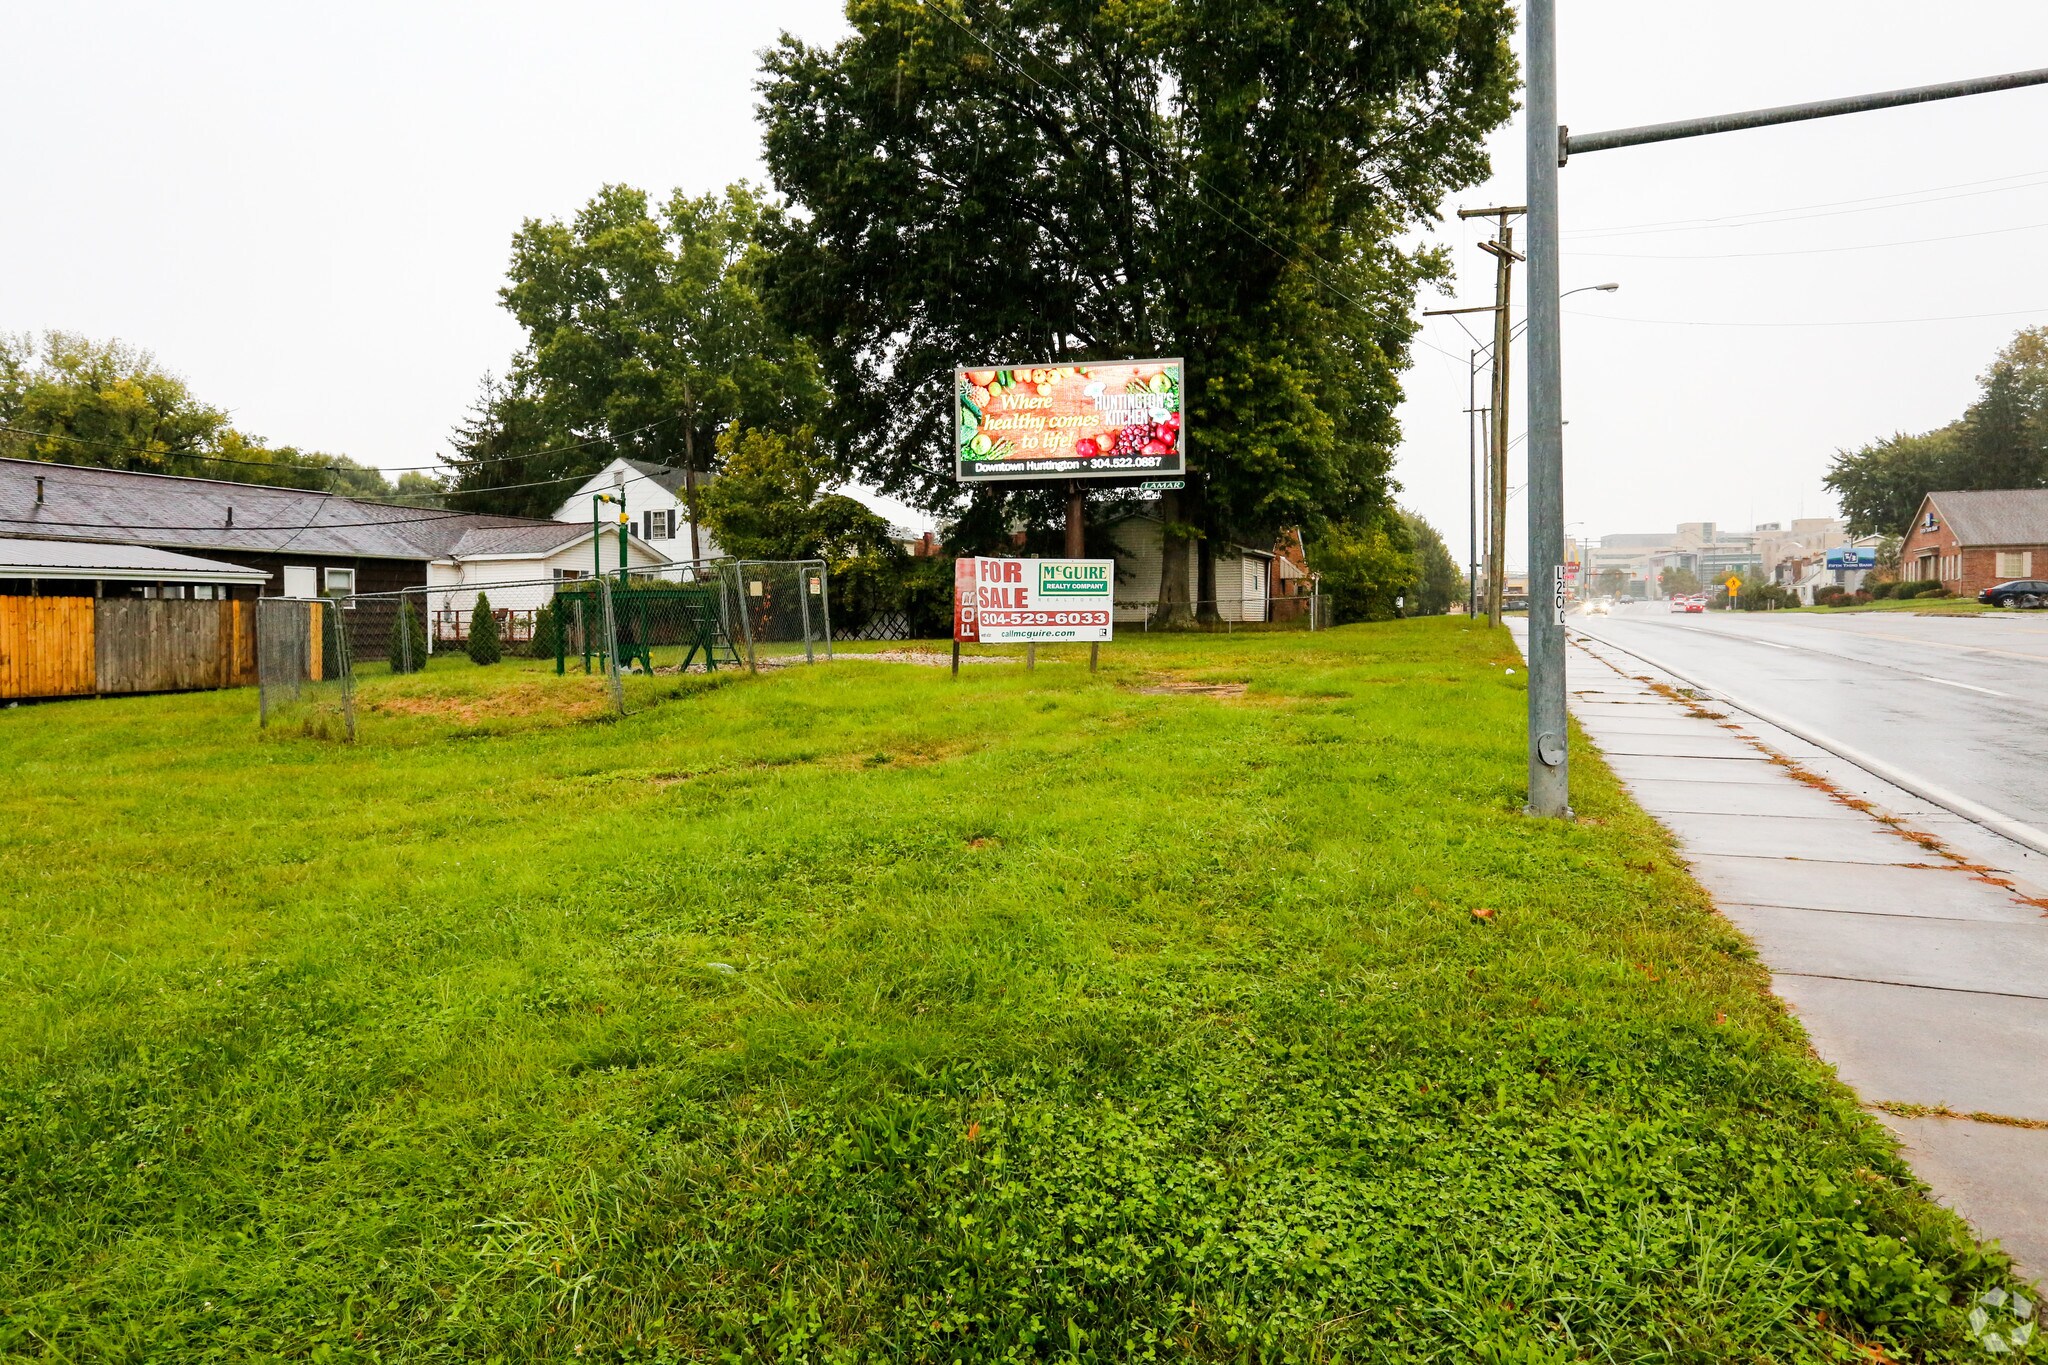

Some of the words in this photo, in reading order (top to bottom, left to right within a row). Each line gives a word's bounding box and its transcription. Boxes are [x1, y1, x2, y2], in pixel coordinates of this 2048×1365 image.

[1001, 393, 1053, 410] Where
[1094, 393, 1174, 410] HUNTINGTON'S
[984, 414, 1046, 432] healthy
[1049, 414, 1100, 427] comes
[1105, 408, 1149, 426] KITCHEN
[1021, 435, 1038, 449] to
[1042, 432, 1075, 453] life!
[975, 462, 1025, 473] Downtown
[1026, 460, 1080, 472] Huntington
[1090, 457, 1162, 469] 304.522.0887
[1144, 482, 1181, 490] LAMAR
[980, 561, 1022, 583] FOR
[978, 586, 1029, 609] SALE
[961, 592, 975, 636] FOR
[982, 613, 1106, 625] 304-529-6033
[1001, 629, 1076, 639] callmcguire.com
